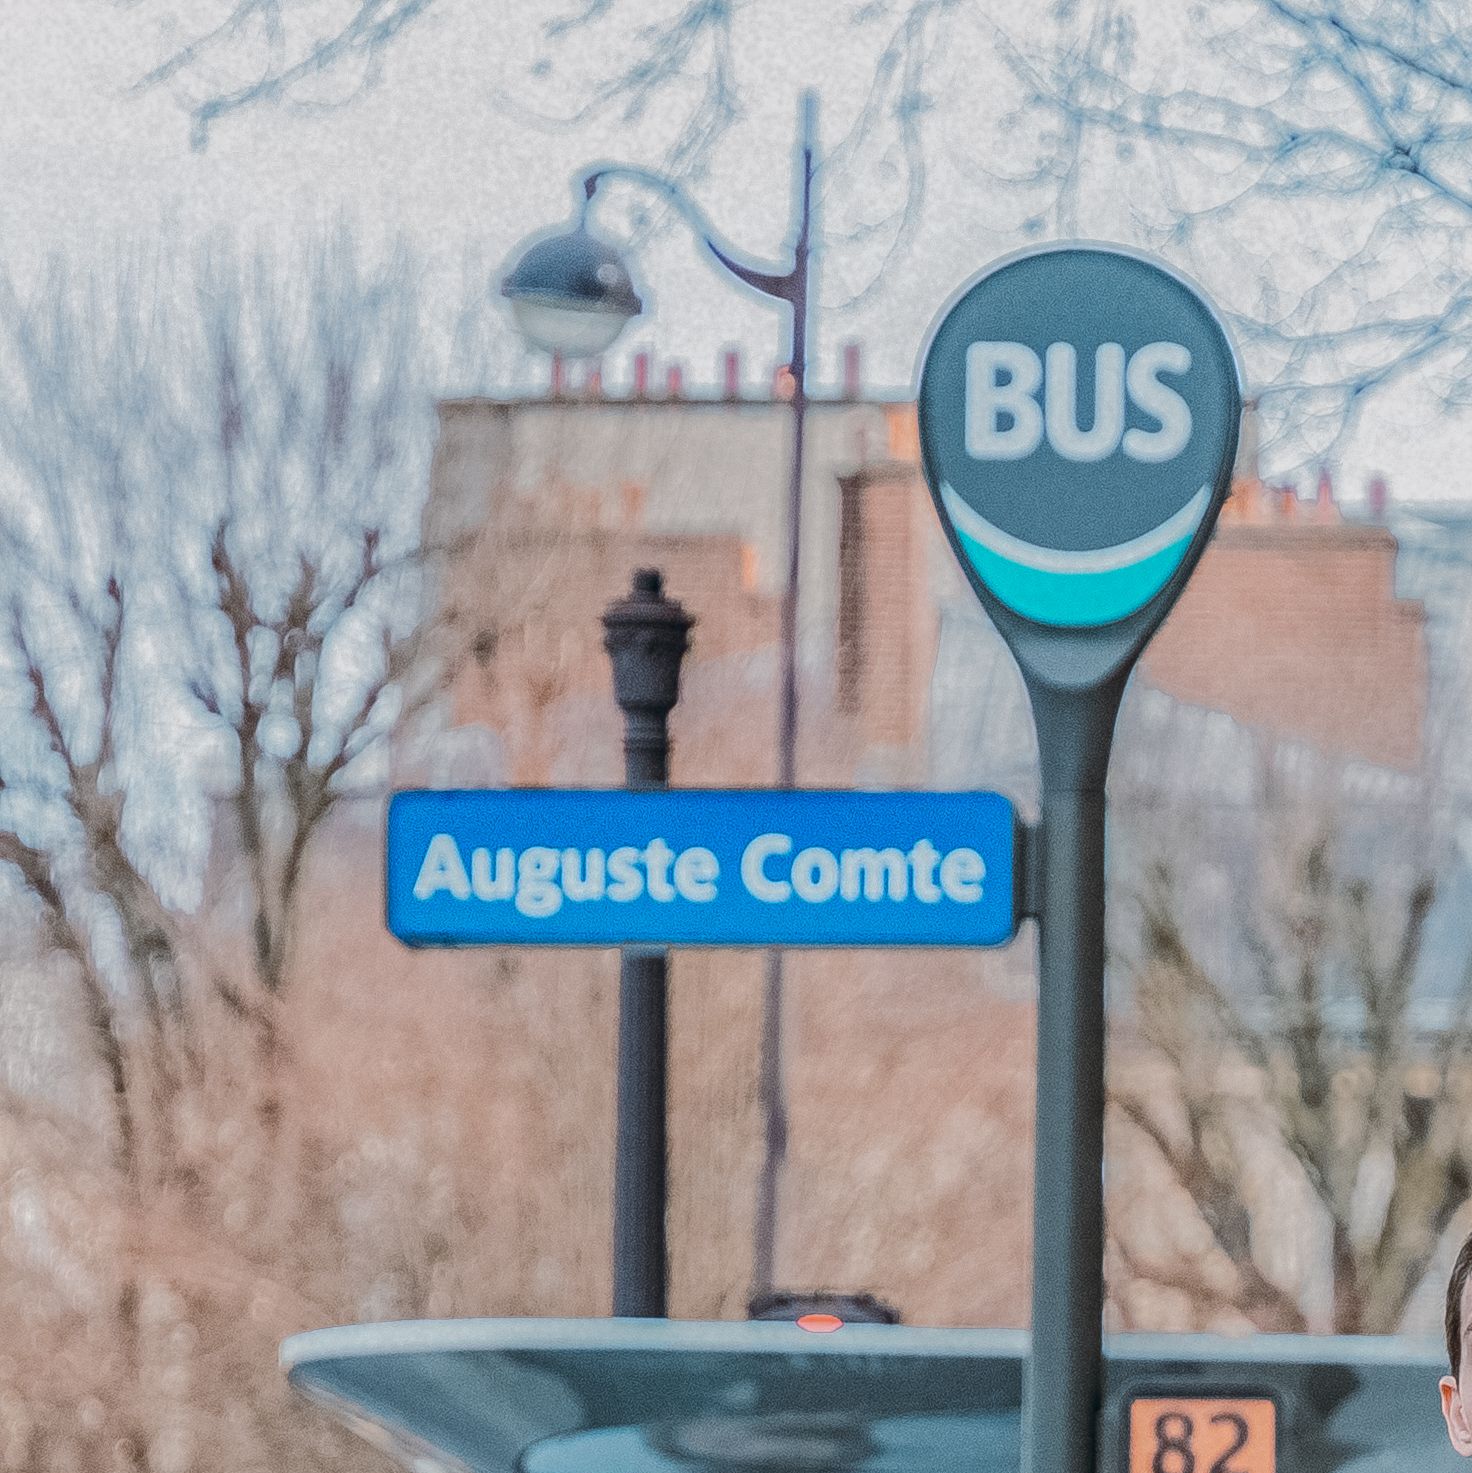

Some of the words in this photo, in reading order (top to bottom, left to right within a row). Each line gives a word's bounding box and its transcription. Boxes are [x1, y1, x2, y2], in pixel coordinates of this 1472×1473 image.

[965, 341, 1192, 462] BUS
[412, 832, 720, 918] Auguste
[740, 832, 988, 902] Comte
